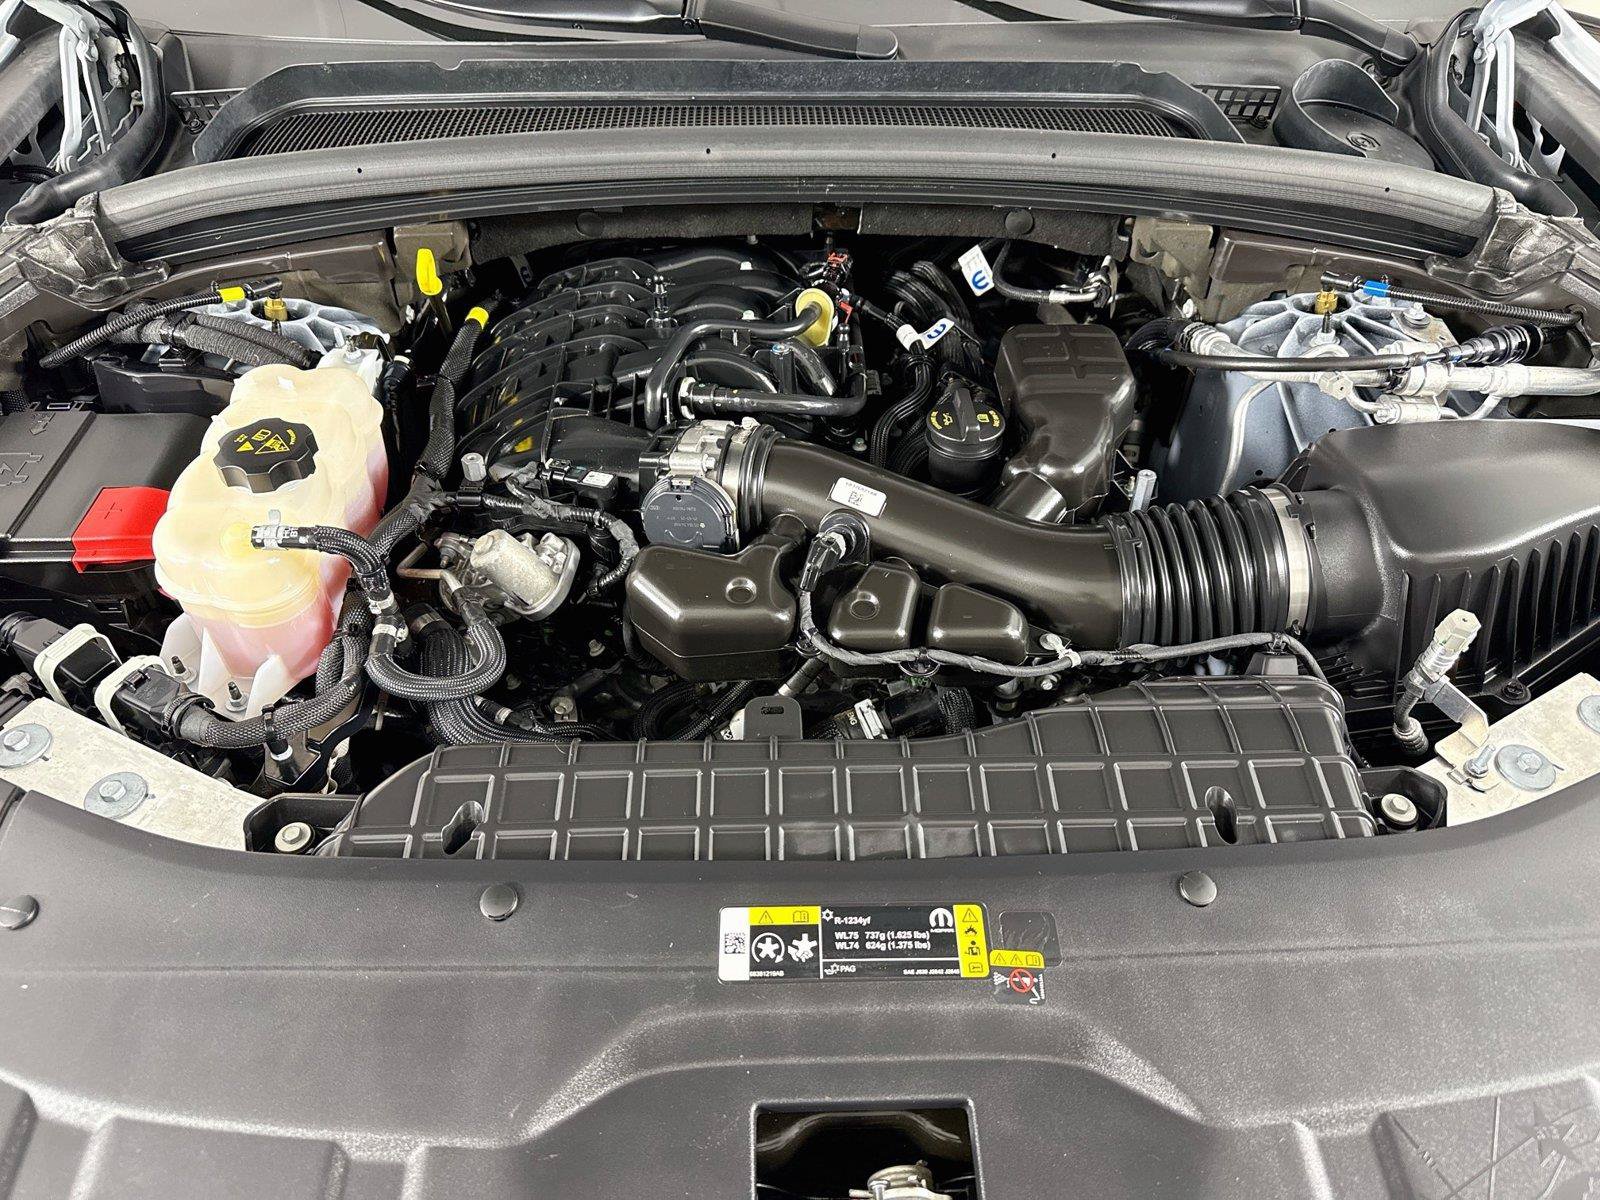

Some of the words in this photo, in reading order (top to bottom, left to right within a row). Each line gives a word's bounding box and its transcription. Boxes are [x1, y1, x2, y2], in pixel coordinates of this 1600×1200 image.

[834, 916, 871, 926] R-1234yf
[834, 931, 859, 940] WL75
[865, 931, 886, 941] 737g
[887, 931, 912, 940] (1.625
[913, 931, 930, 940] lbs)
[835, 941, 860, 950] WL74
[865, 941, 887, 951] 624g
[888, 941, 913, 950] (1.375
[914, 941, 931, 950] lbs)
[840, 965, 857, 973] PAG
